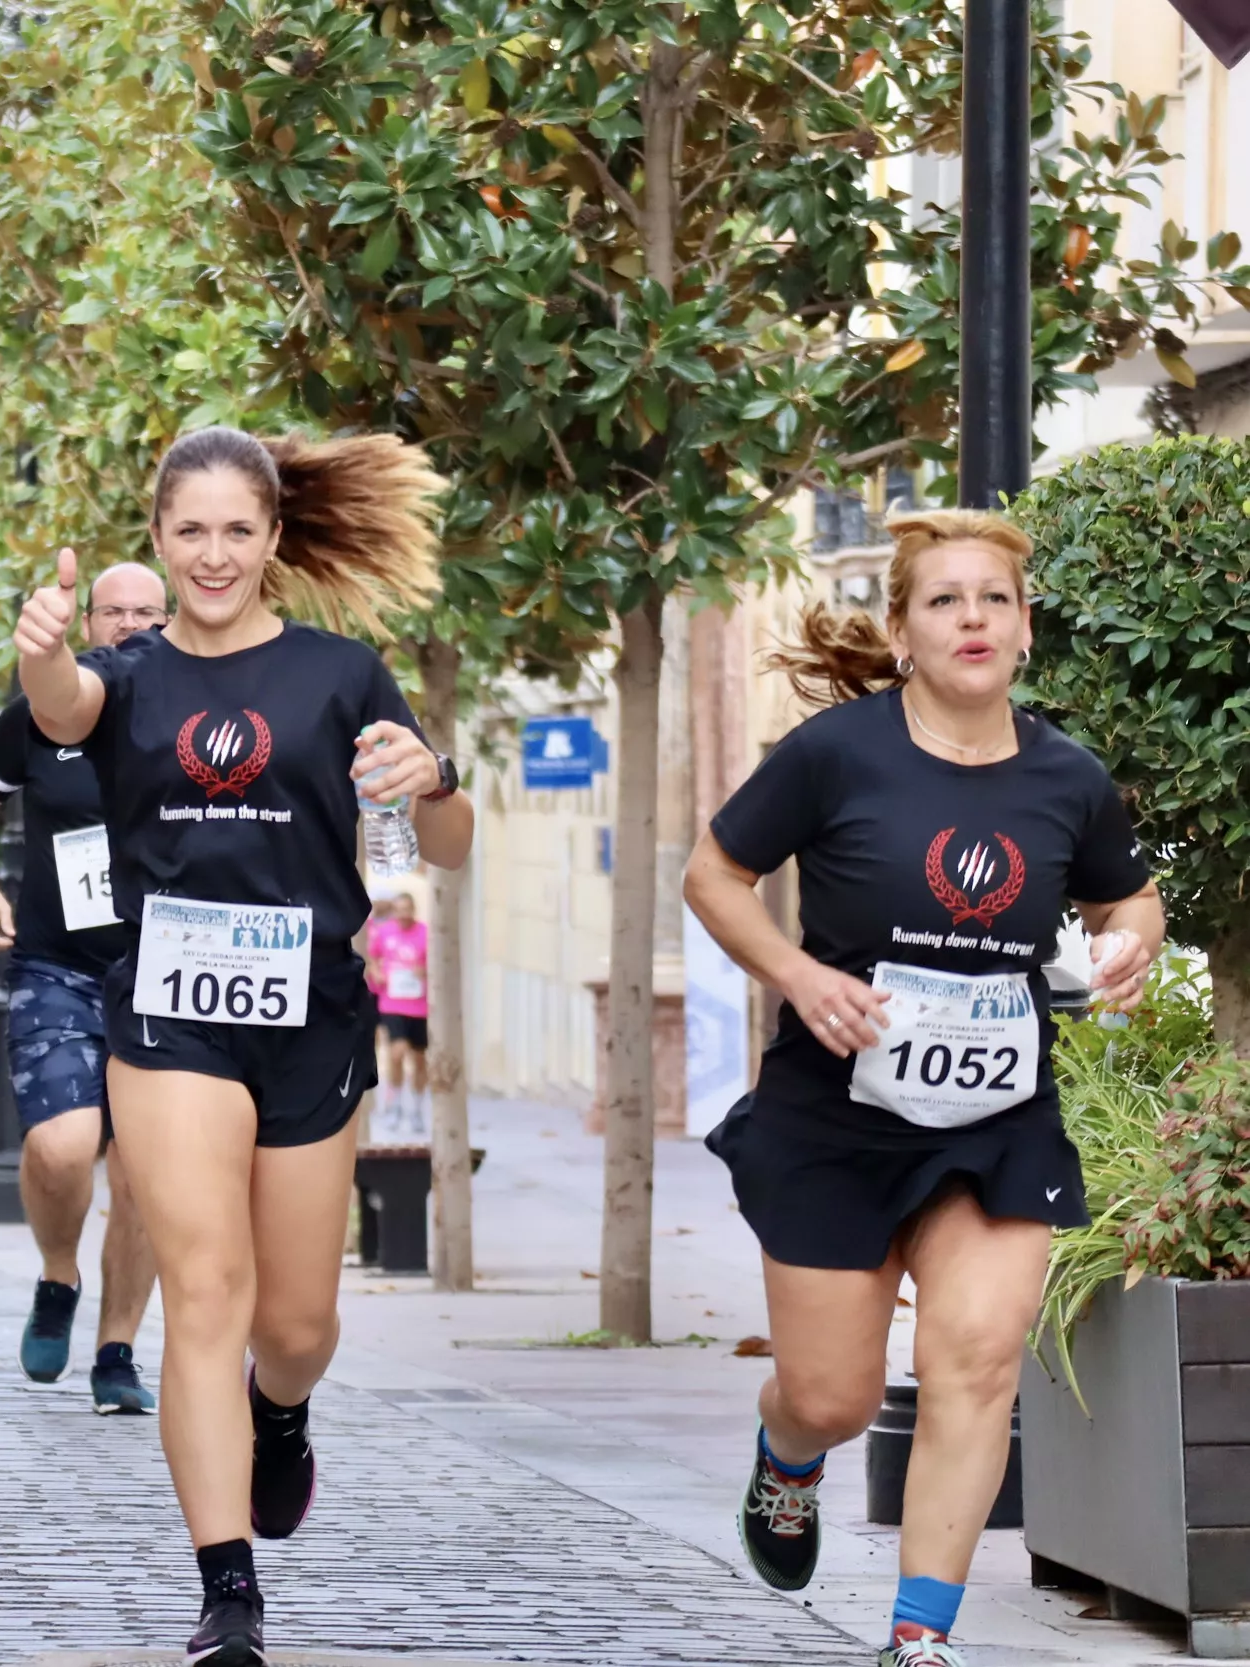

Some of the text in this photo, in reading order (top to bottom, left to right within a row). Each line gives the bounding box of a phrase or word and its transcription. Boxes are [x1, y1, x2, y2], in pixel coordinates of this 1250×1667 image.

[160, 803, 292, 822] Running down the street
[233, 911, 277, 929] 2024
[892, 926, 1035, 956] Running down the street
[162, 968, 288, 1021] 1065
[974, 981, 1011, 1000] 2024
[888, 1040, 1020, 1092] 1052
